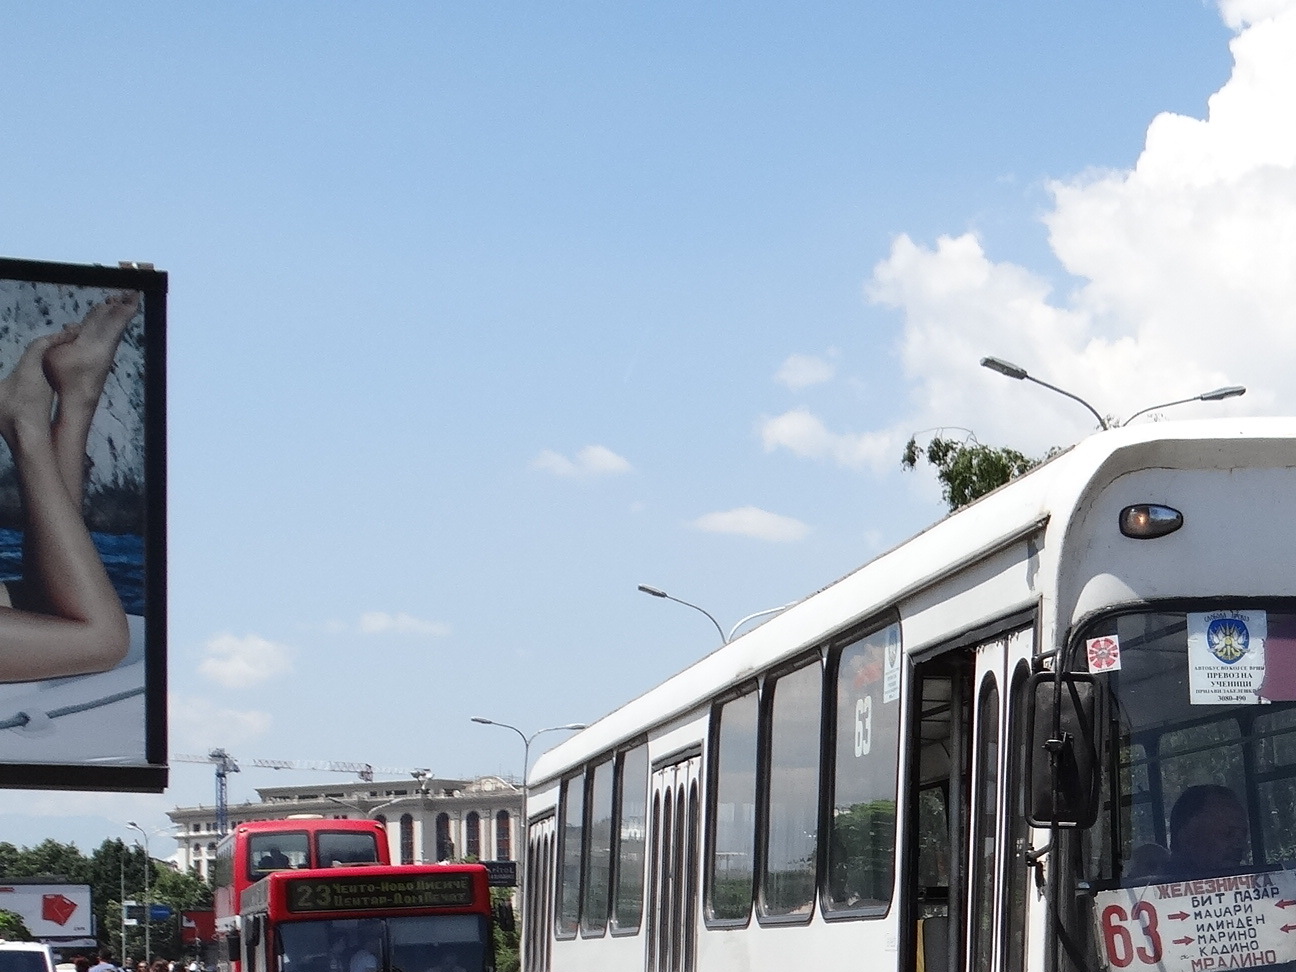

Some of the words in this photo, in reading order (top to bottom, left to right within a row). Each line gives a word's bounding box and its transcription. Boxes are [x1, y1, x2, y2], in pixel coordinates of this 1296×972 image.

[854, 695, 872, 758] 63
[296, 884, 332, 907] 23
[1157, 874, 1274, 900] ЖЕЛЕЗНИЧКА
[1191, 892, 1226, 908] БИТ
[1234, 887, 1280, 903] ПАЗАР
[1102, 900, 1163, 968] 63
[1196, 914, 1266, 933] ИЛИНДЕН
[1197, 928, 1257, 945] МАРИНО
[1199, 940, 1259, 957] КАДИНО
[1191, 950, 1277, 972] МРАЛИНО
